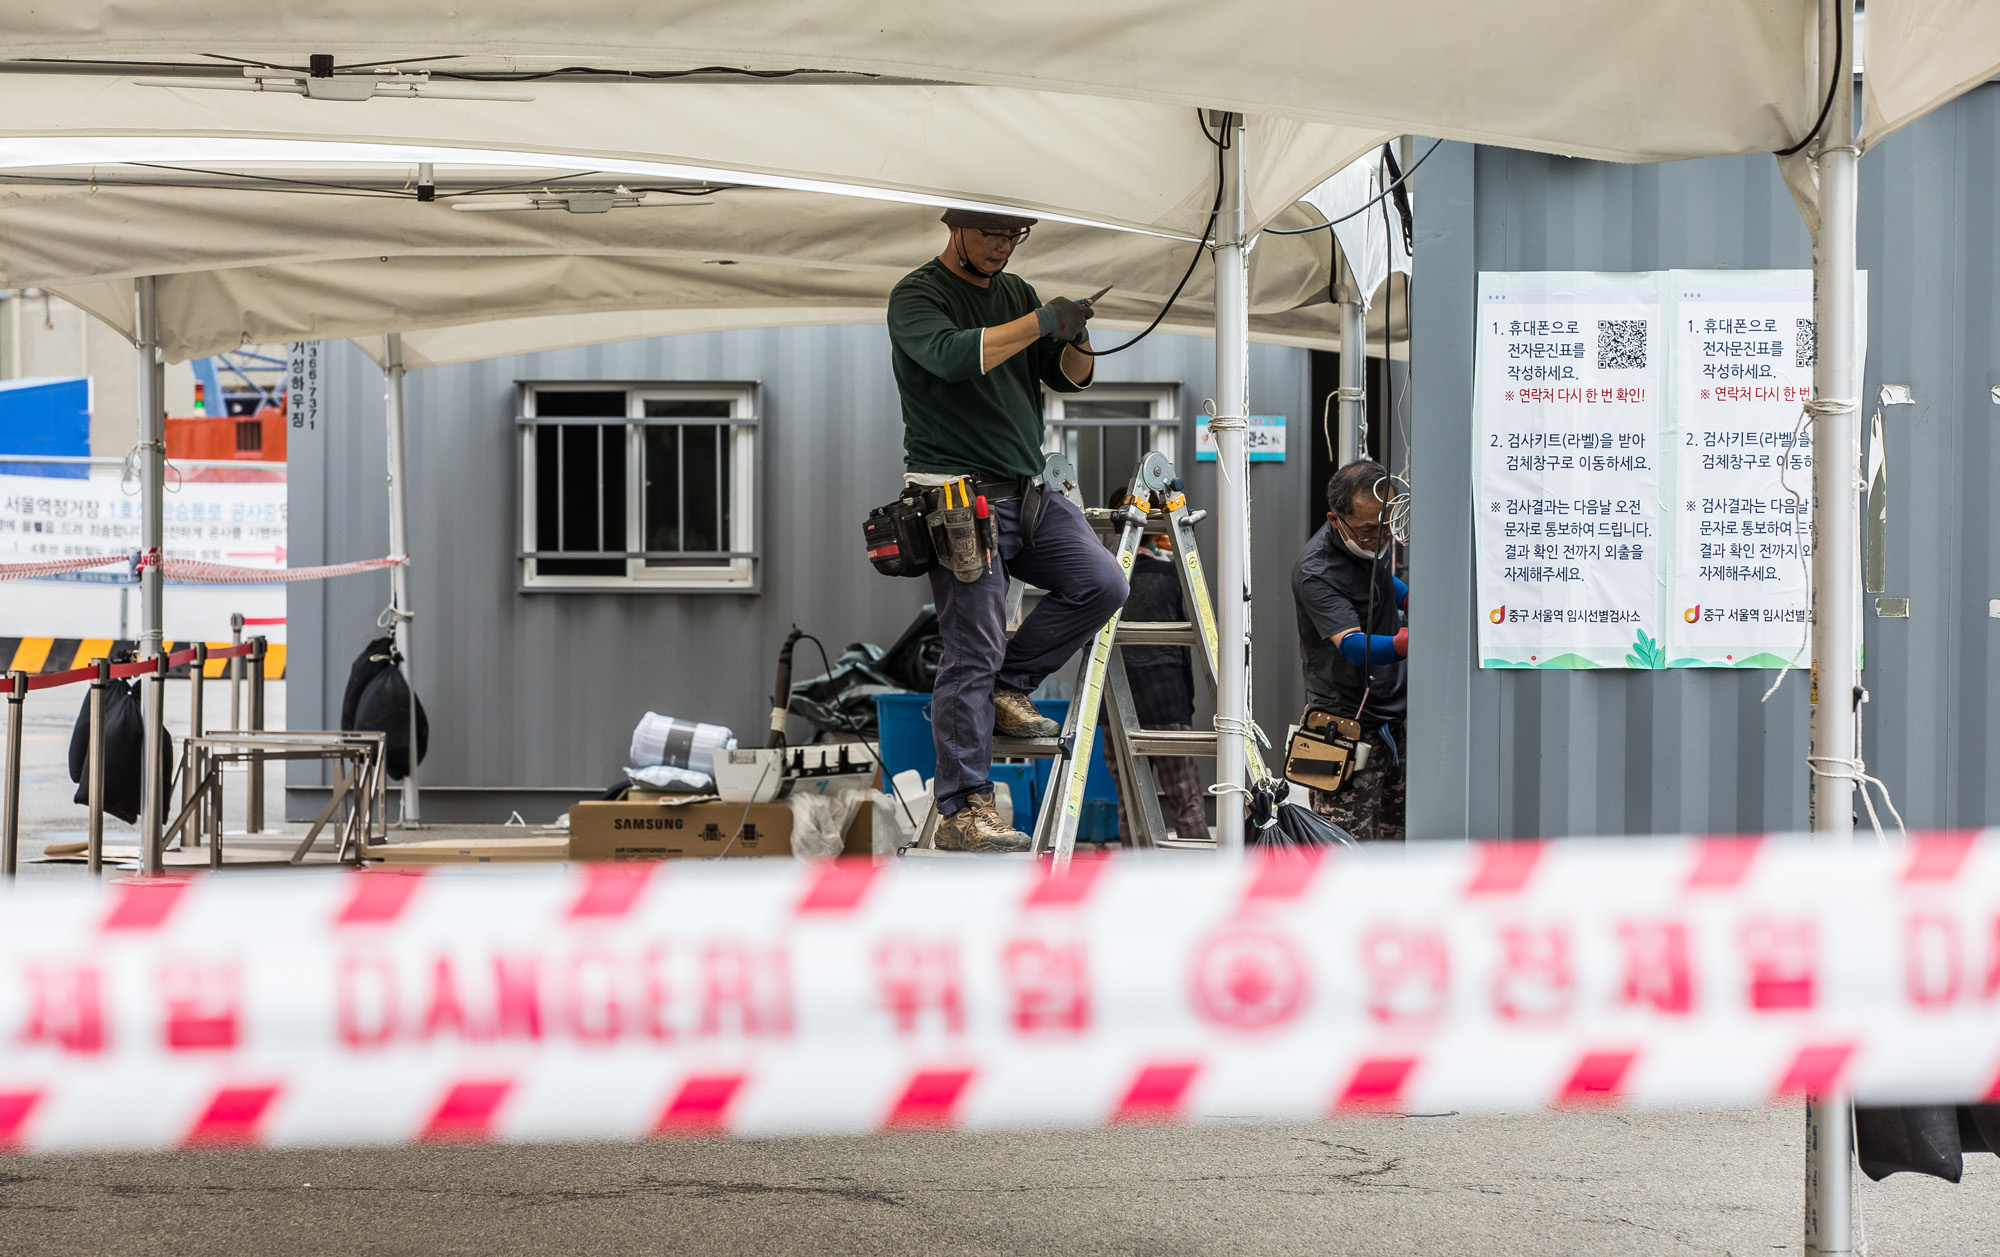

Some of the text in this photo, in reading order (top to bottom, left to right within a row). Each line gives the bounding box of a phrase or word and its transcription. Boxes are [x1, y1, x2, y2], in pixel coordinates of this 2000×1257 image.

[1492, 321, 1580, 336] 1. 휴대폰으로
[1687, 319, 1778, 334] 1. 휴대폰으로
[1507, 343, 1586, 358] 전자문진표를
[1702, 341, 1784, 356] 전자문진표를
[1507, 366, 1579, 381] 작성하세요.
[1702, 364, 1777, 379] 작성하세요.
[1519, 388, 1554, 403] 연락처
[1557, 388, 1582, 403] 다시
[1585, 389, 1598, 403] 한
[1601, 389, 1613, 403] 번
[1616, 388, 1645, 403] 확인!
[1714, 387, 1751, 401] 연락처
[1755, 387, 1780, 401] 다시
[1783, 387, 1797, 401] 한
[1798, 387, 1812, 402] 번
[1490, 433, 1646, 449] 2. 검사키트(라벨)을 받아
[1685, 432, 1811, 448] 2. 검사키트(라벨)을
[1506, 456, 1651, 471] 검체창구로 이동하세요.
[1702, 454, 1772, 469] 검체창구로
[5, 496, 100, 519] 서울역정거장
[109, 501, 142, 520] 1호
[1506, 499, 1571, 515] 검사결과는
[1574, 500, 1613, 515] 다음날
[1614, 500, 1641, 514] 오전
[1702, 498, 1767, 513] 검사결과는
[1770, 498, 1810, 514] 다음날
[1504, 522, 1652, 537] 문자로 통보하여 드립니다.
[1699, 521, 1739, 536] 문자로
[1740, 521, 1792, 536] 통보하여
[1504, 544, 1644, 560] 결과 확인 전까지 외출을
[1700, 543, 1726, 558] 결과
[1729, 543, 1755, 558] 확인
[1759, 544, 1798, 559] 전까지
[1503, 567, 1584, 582] 자제해주세요.
[1699, 566, 1781, 581] 자제해주세요.
[1508, 610, 1641, 622] 중구 서울역 임시선별검사소
[1703, 609, 1726, 621] 중구
[1727, 609, 1760, 622] 서울역
[614, 818, 684, 830] SAMSUNG
